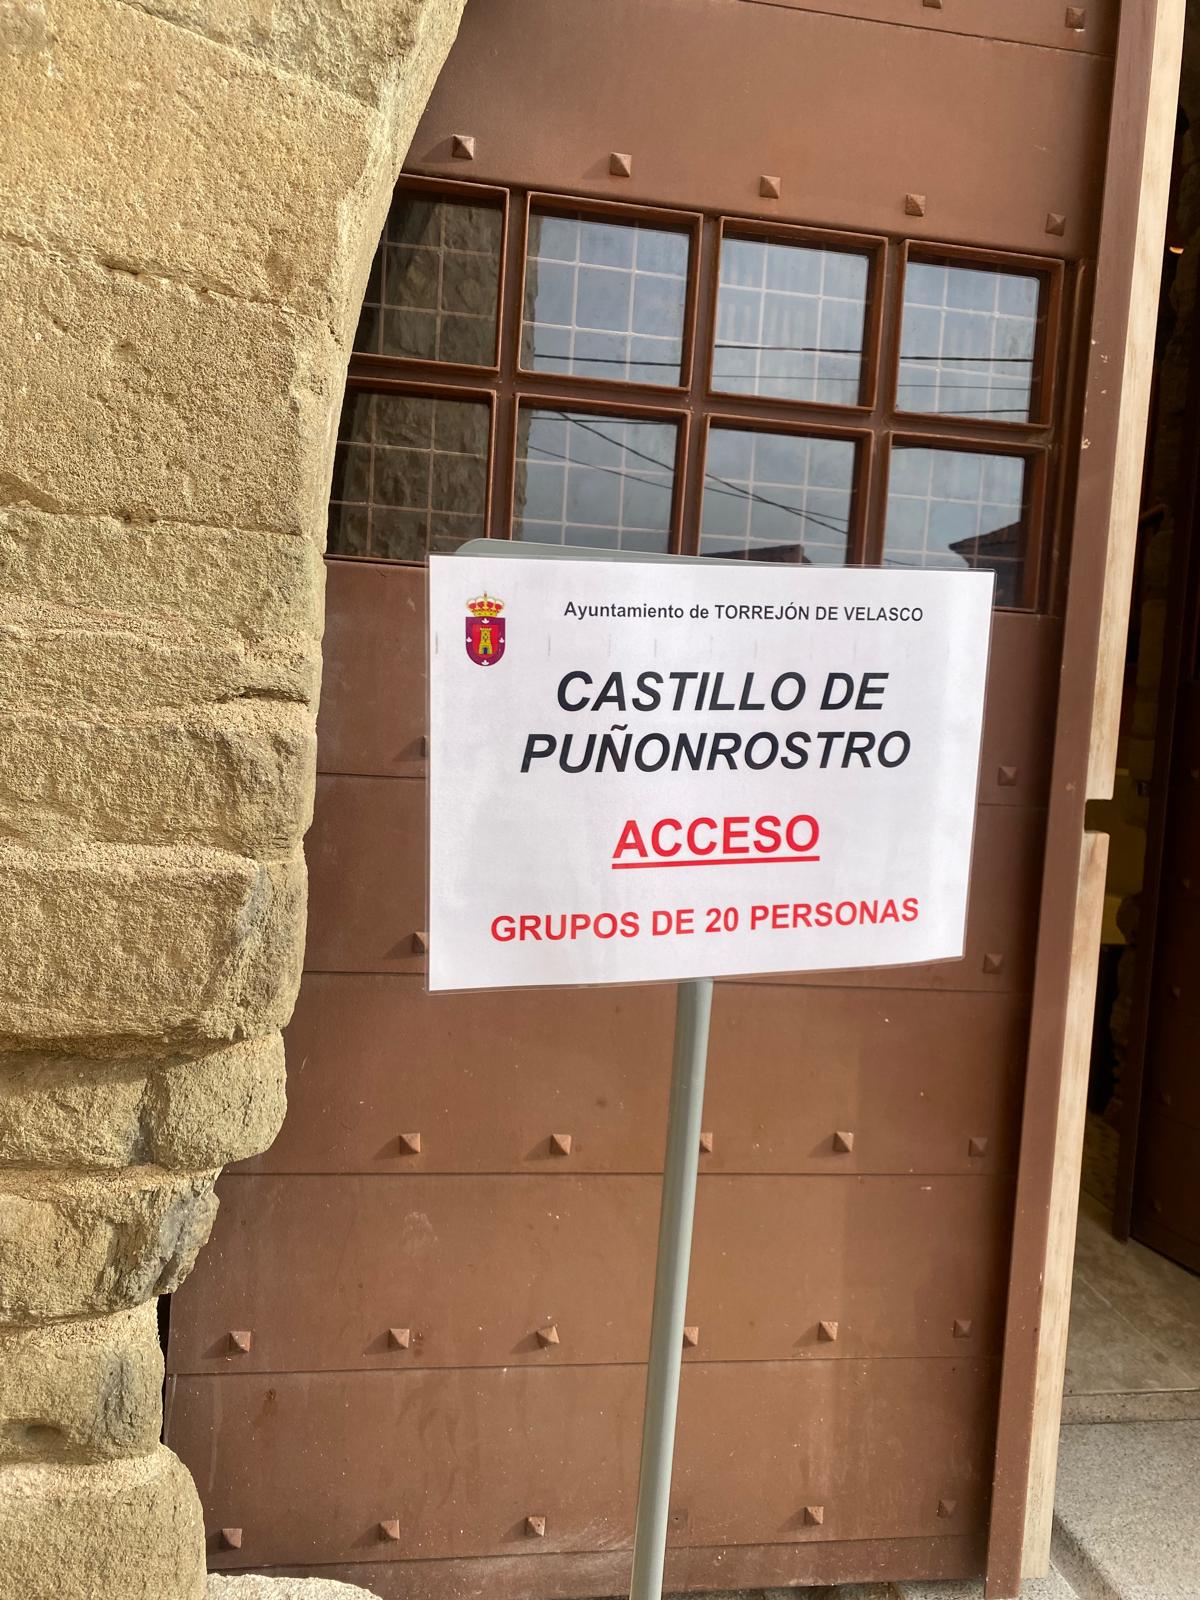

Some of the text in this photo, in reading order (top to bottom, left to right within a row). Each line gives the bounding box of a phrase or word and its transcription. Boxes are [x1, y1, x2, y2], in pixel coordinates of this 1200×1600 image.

[563, 601, 923, 622] Ayuntamiento de TORREJÓN DE VELASCO
[557, 670, 890, 712] CASTILLO DE
[519, 723, 911, 774] PUÑONROSTRO
[611, 814, 821, 861] ACCESO
[490, 897, 919, 942] GRUPOS DE 20 PERSONAS
